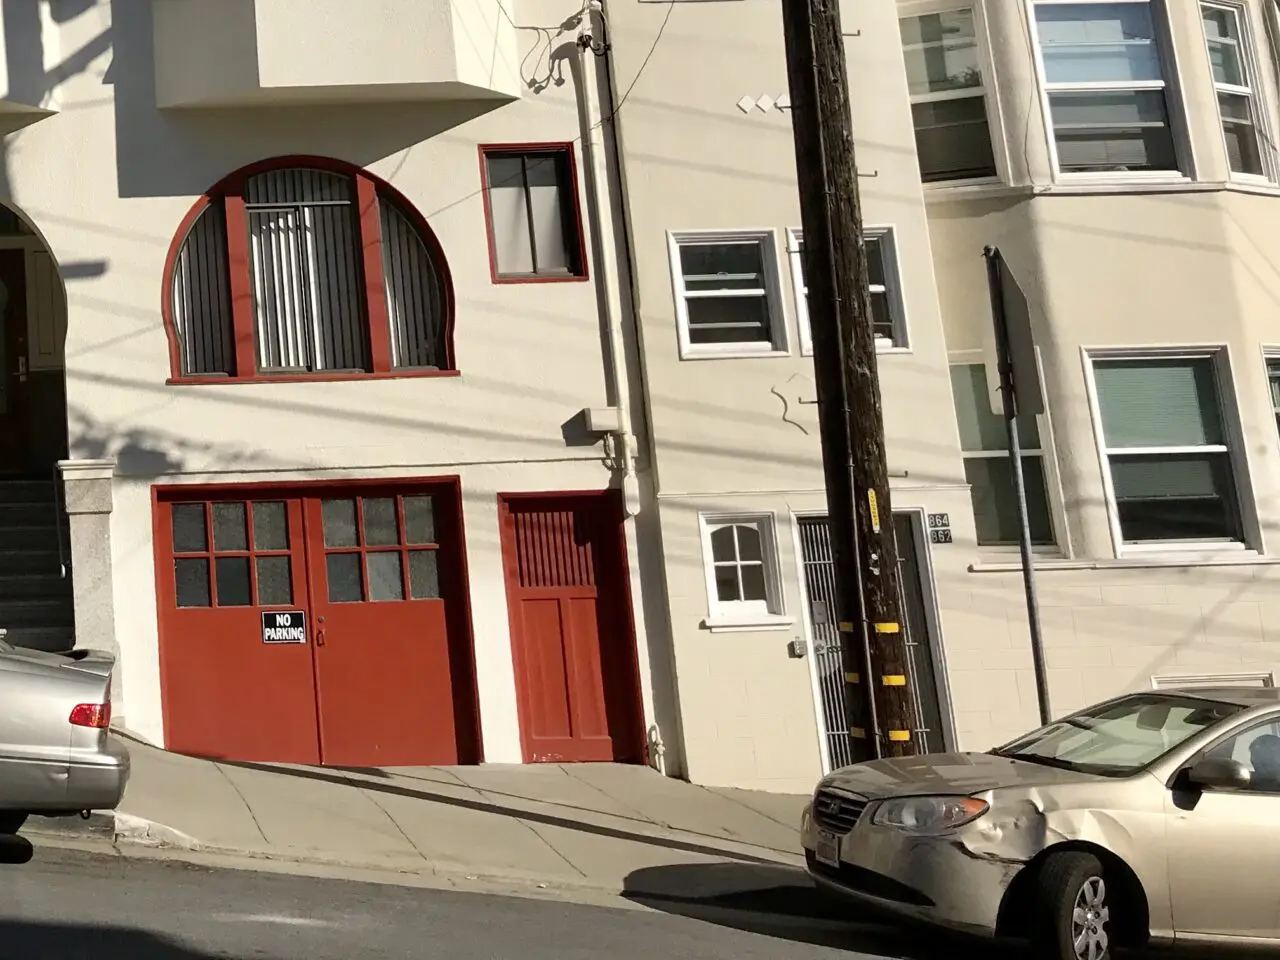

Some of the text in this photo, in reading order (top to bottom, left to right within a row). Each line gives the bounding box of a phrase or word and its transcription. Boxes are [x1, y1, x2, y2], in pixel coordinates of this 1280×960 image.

[928, 514, 948, 526] 864
[931, 530, 952, 542] 862
[276, 614, 291, 626] NO
[265, 627, 303, 640] PARKING
